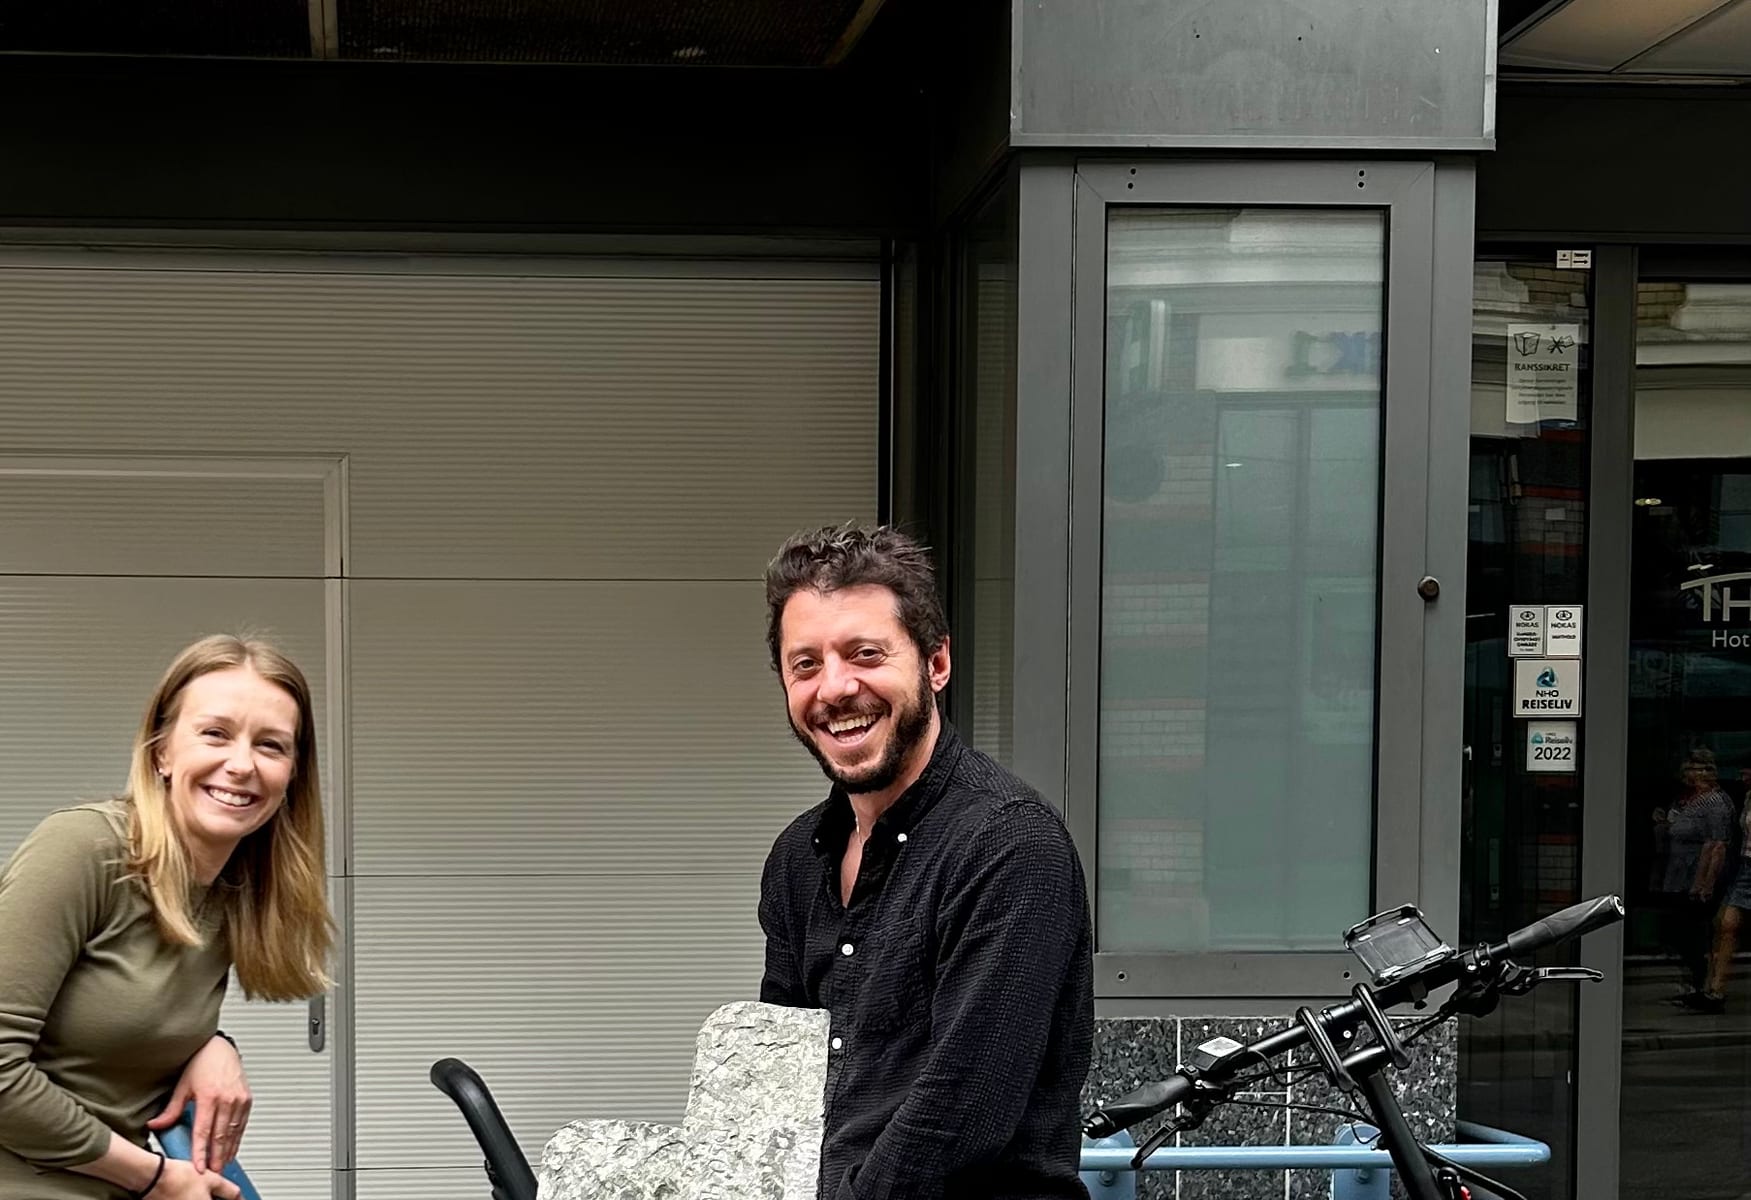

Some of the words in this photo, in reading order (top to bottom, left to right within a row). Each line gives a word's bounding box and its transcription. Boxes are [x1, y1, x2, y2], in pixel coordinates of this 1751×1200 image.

[1712, 629, 1751, 648] Hot
[1535, 690, 1559, 698] NHO
[1522, 699, 1573, 710] REISELIV
[1534, 747, 1571, 761] 2022
